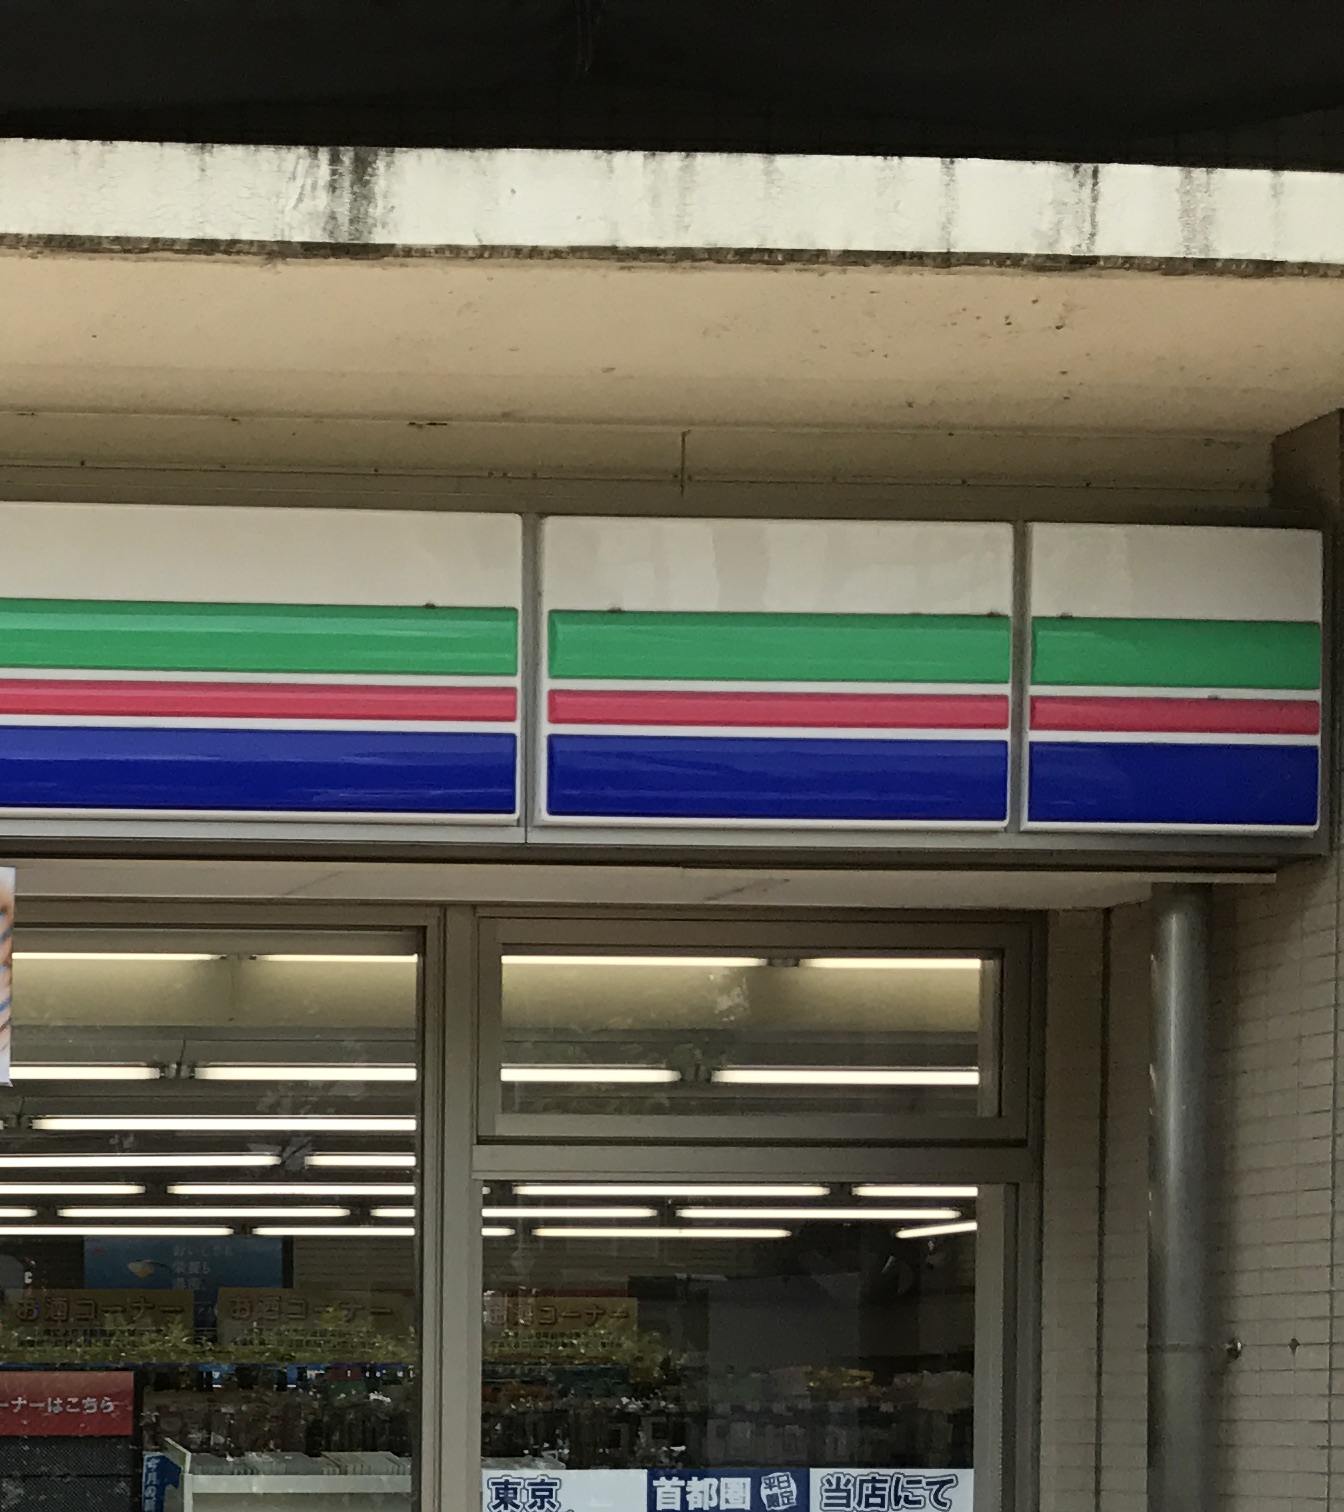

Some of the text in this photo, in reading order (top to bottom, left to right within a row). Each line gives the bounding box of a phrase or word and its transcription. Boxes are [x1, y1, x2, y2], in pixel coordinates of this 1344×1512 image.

[490, 1476, 560, 1512] 東京
[653, 1477, 752, 1511] 首都圏
[763, 1473, 792, 1491] 平日
[821, 1473, 956, 1512] 当店にて
